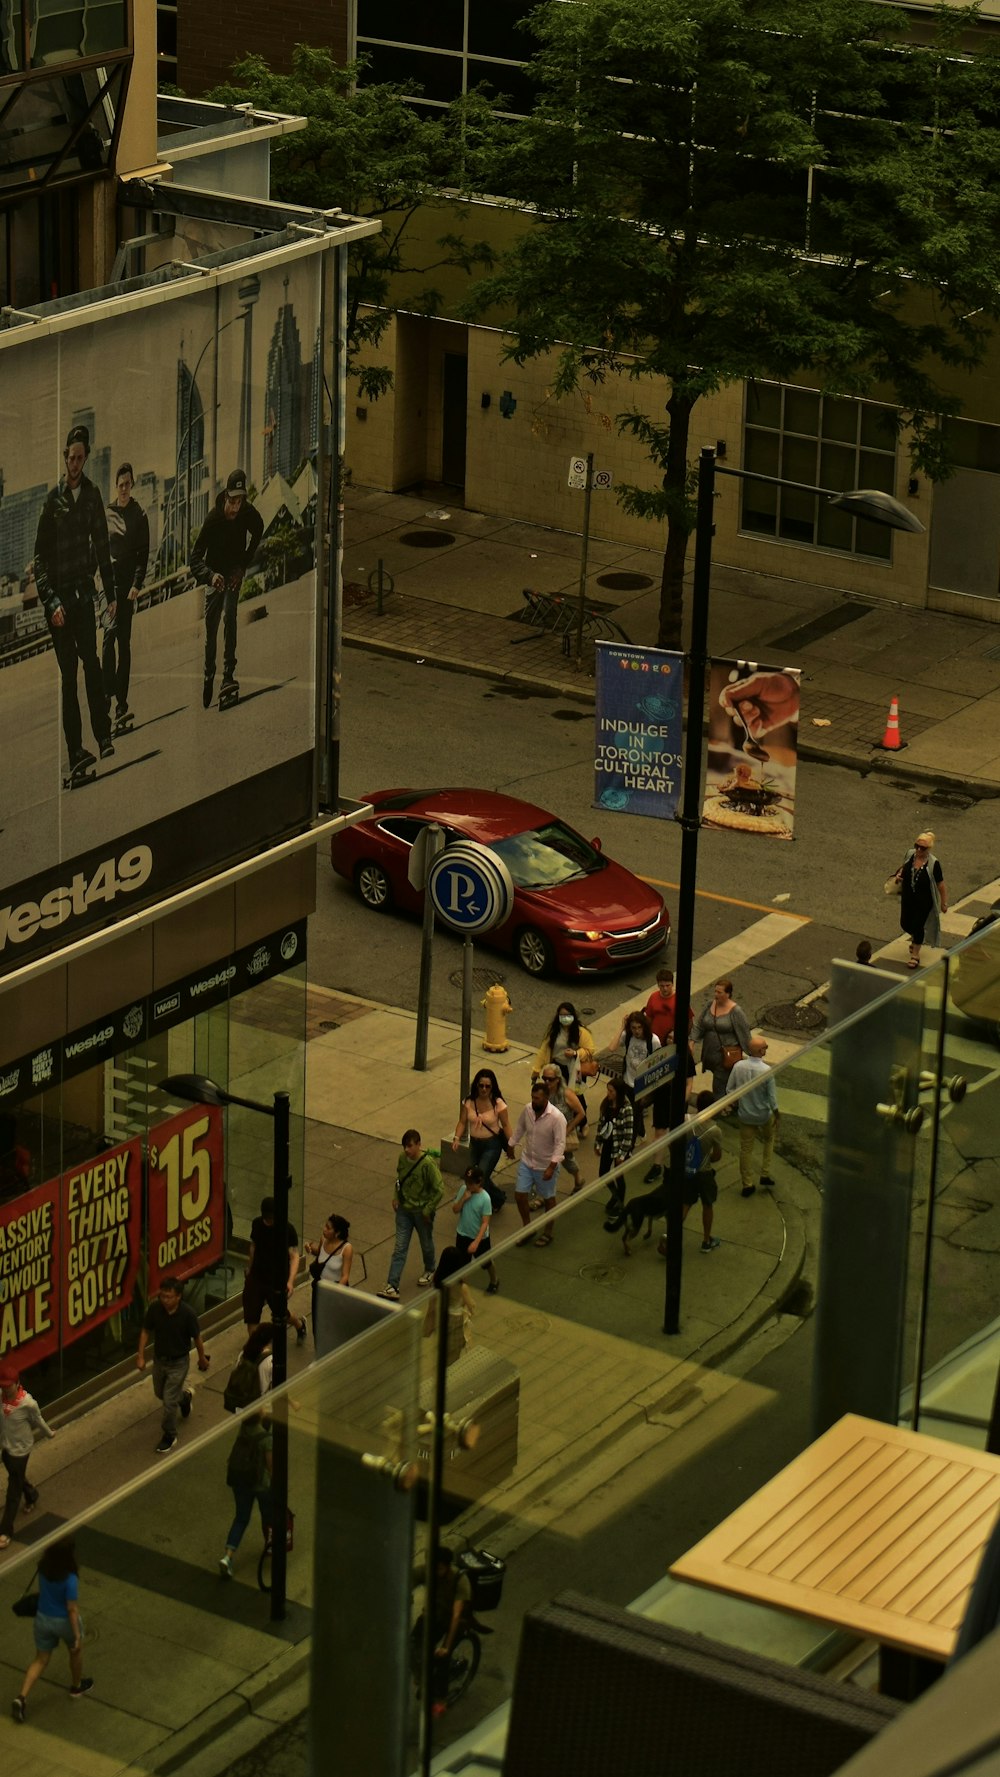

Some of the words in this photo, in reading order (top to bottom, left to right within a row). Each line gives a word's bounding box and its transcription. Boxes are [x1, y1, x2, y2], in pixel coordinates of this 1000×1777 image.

[608, 651, 645, 660] DOWNTOWN
[601, 718, 668, 738] INDULGE
[628, 736, 644, 749] IN
[594, 759, 670, 780] CULTURAL
[598, 745, 683, 769] TORONTO'S
[624, 777, 675, 794] HEART
[0, 844, 153, 951] est49
[447, 871, 476, 913] P
[190, 966, 237, 997] West49
[65, 1025, 114, 1059] West49
[68, 1150, 130, 1210] EVERY
[68, 1186, 129, 1245] THING
[68, 1226, 128, 1282] GOTTA
[158, 1235, 176, 1268] OR
[179, 1217, 211, 1254] LESS
[68, 1256, 127, 1326] GO!!!
